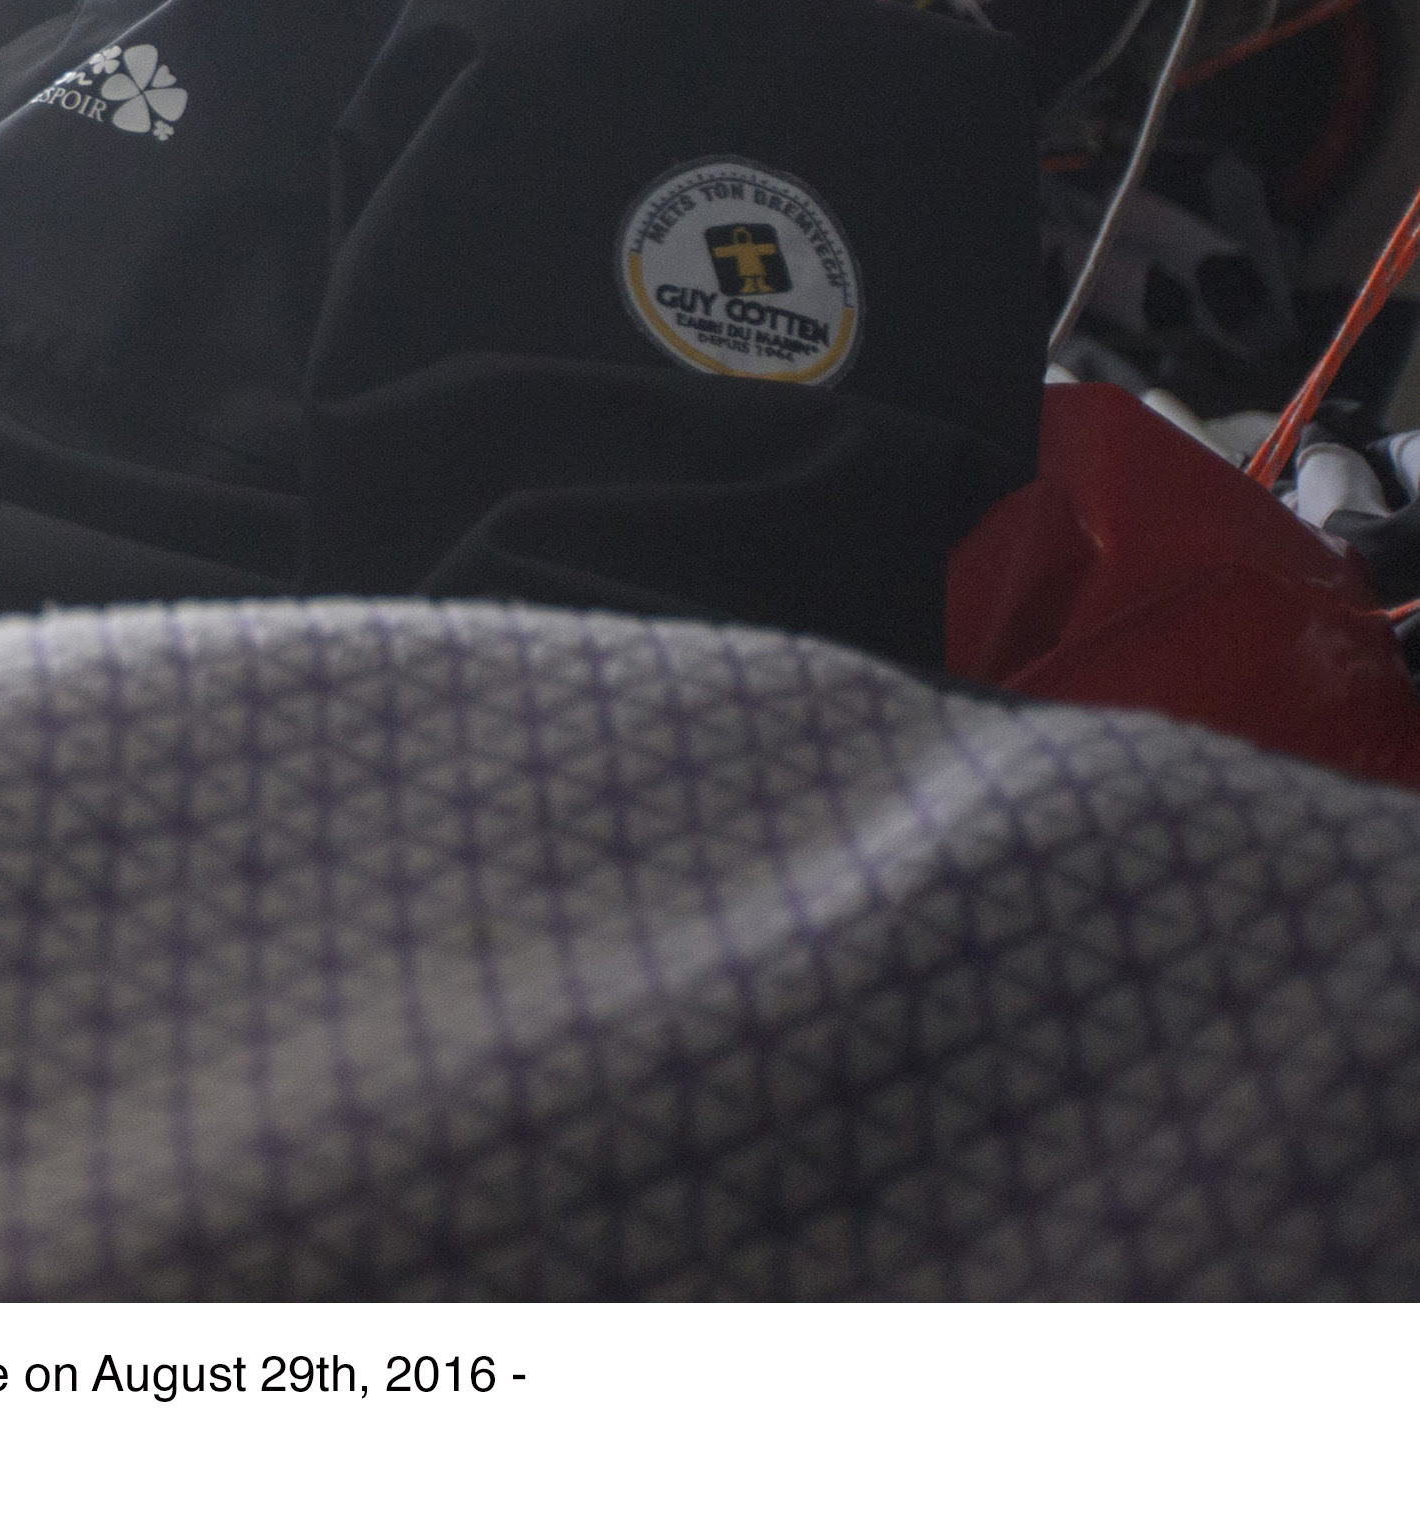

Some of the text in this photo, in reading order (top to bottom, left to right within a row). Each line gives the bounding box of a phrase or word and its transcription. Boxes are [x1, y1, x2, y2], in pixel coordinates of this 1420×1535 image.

[29, 85, 106, 122] SPOIR
[657, 284, 830, 345] GUY COTTEN
